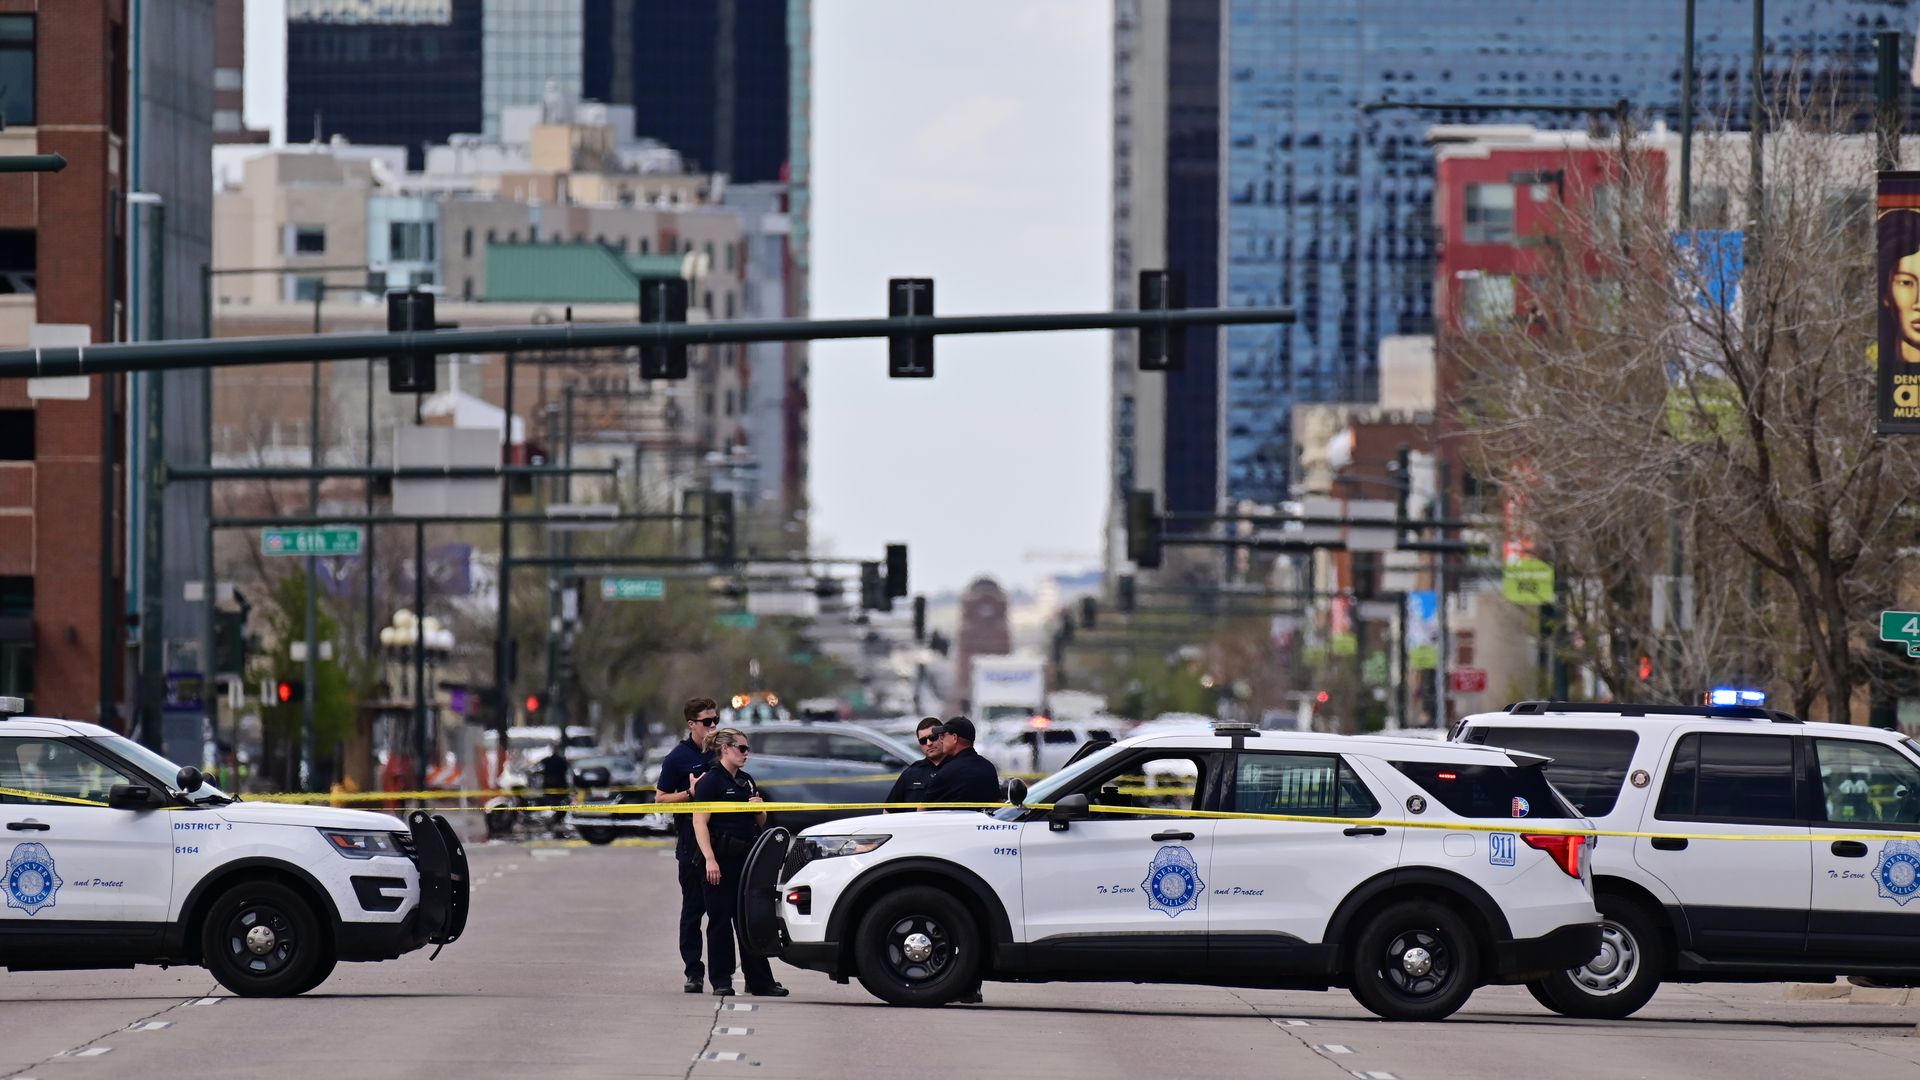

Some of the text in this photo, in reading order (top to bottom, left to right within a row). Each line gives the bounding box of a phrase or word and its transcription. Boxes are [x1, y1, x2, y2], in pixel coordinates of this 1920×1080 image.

[1894, 375, 1920, 384] DEN
[1893, 384, 1920, 408] a
[1901, 617, 1920, 637] 4
[174, 822, 233, 831] DISTRICT 3
[175, 846, 199, 854] 6164
[993, 847, 1018, 856] 0176
[1492, 835, 1512, 859] 911
[1885, 855, 1920, 869] DENVER
[13, 863, 48, 878] DENVER
[1155, 866, 1191, 881] DENVER
[1828, 870, 1865, 879] To Serve
[73, 878, 124, 888] and Protect
[1096, 884, 1136, 894] To Serve
[1886, 881, 1919, 894] POLICE
[15, 891, 48, 903] POLICE
[1214, 886, 1264, 896] and Protect
[1157, 893, 1190, 906] POLICE
